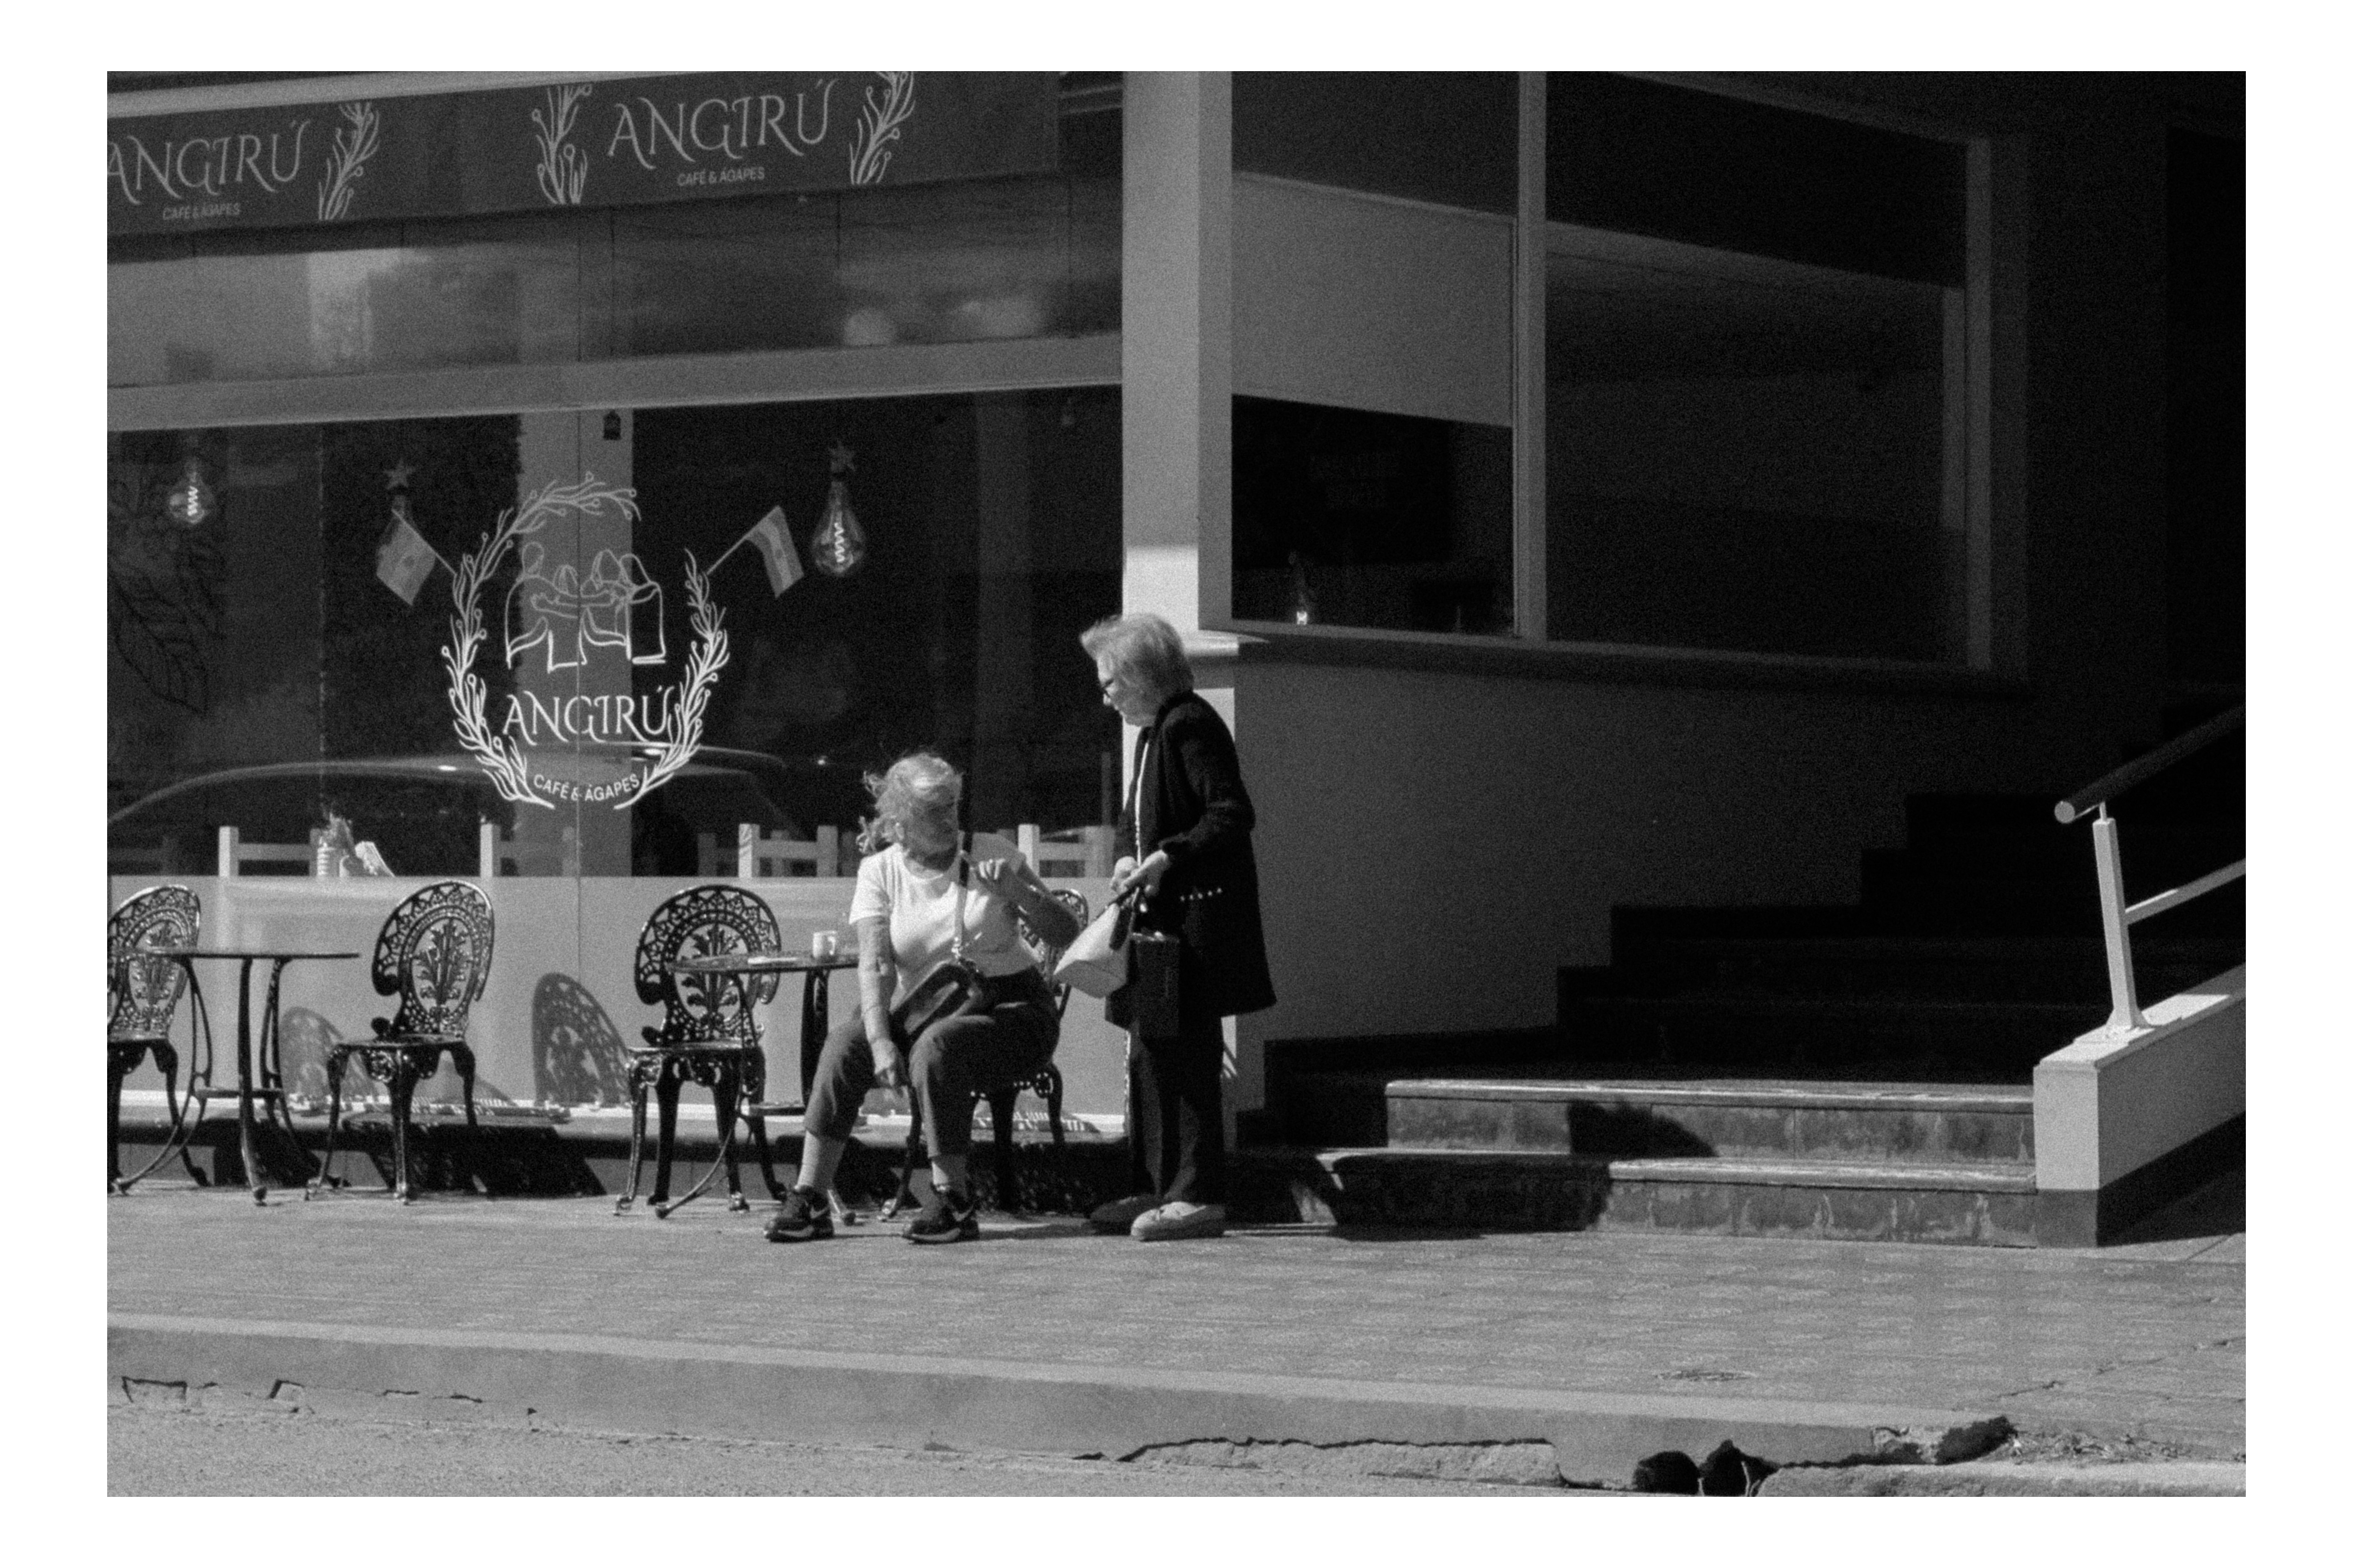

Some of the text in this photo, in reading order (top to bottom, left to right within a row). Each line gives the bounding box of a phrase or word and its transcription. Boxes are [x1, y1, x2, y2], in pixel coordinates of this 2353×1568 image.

[606, 78, 839, 170] ANGIRÚ
[677, 168, 707, 187] CAFÉ
[502, 685, 675, 745] ANGIRÚ
[533, 773, 640, 802] CAFÉ & ÁGAPES
